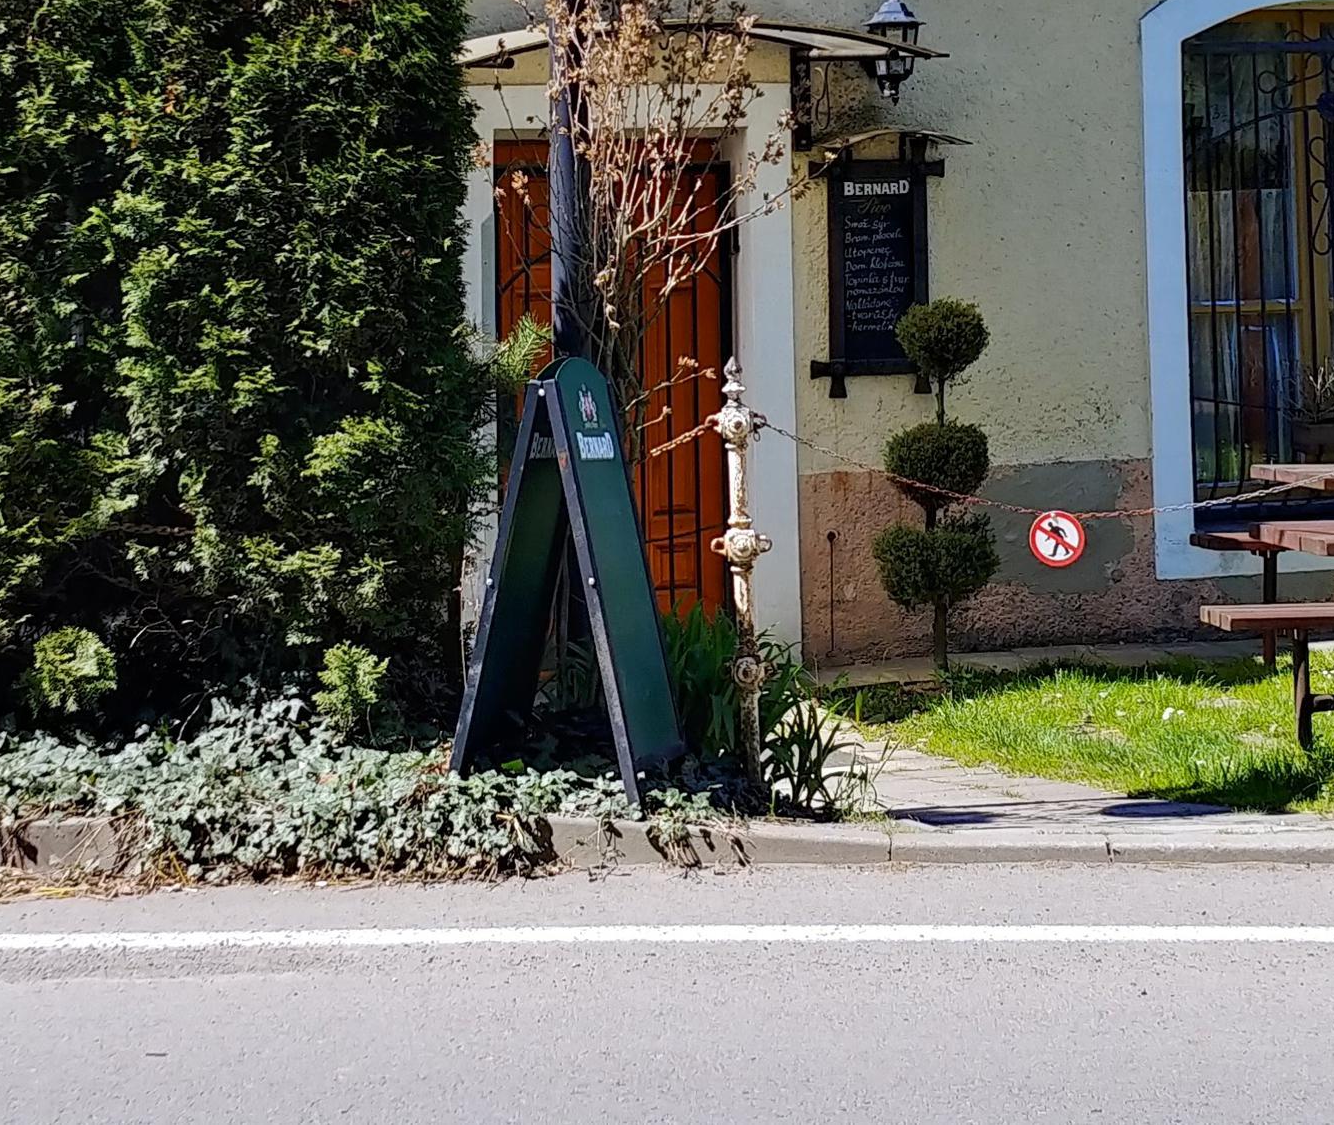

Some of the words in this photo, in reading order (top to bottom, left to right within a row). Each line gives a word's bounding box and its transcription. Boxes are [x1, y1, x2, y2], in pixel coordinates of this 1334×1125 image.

[843, 179, 910, 196] BERNARD
[529, 432, 557, 459] BERN
[575, 431, 614, 460] BERNARD
